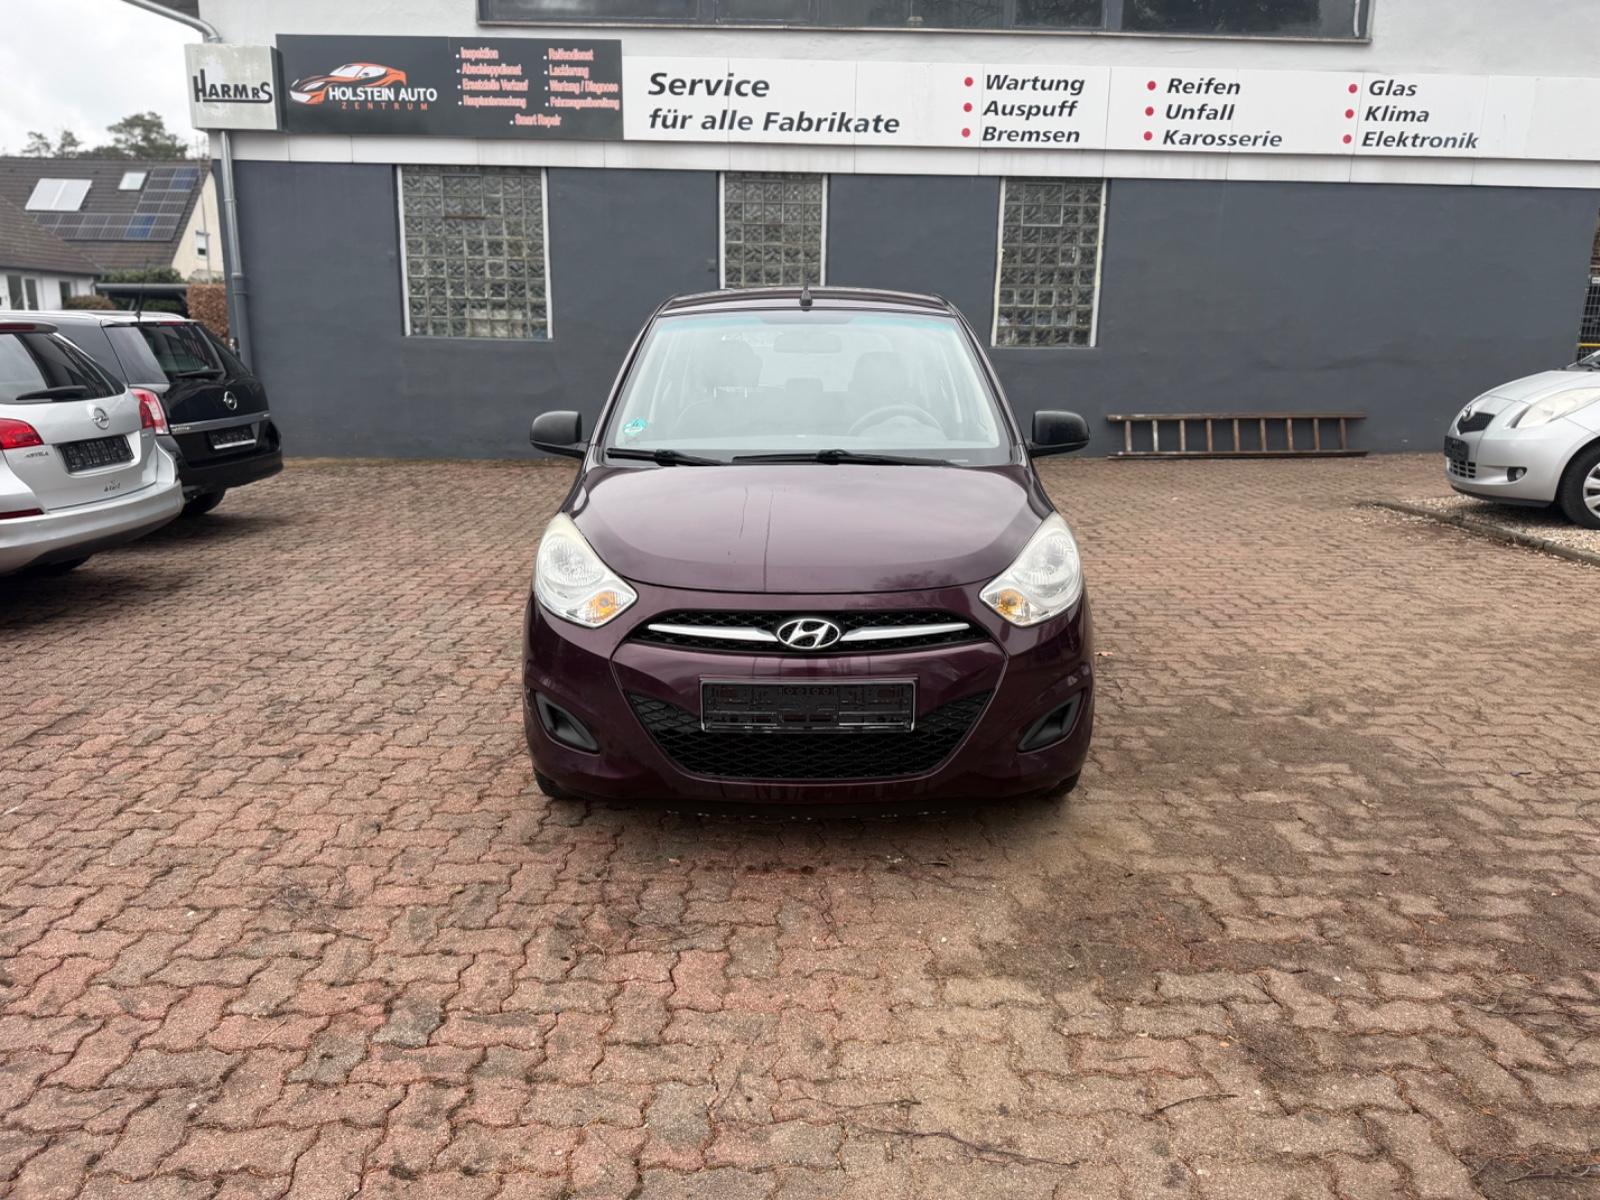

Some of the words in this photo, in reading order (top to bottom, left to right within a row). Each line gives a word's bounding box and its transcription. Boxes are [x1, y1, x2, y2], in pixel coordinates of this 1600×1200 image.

[328, 86, 395, 102] HOLSTEIN
[398, 87, 438, 102] AUTO
[648, 73, 770, 97] Service
[986, 74, 1085, 96] Wartung
[1167, 77, 1241, 95] Reifen
[1369, 79, 1417, 97] Glas
[341, 102, 429, 111] ZENTRUM
[983, 100, 1078, 120] Auspuff
[1165, 103, 1235, 121] Unfall
[1364, 105, 1430, 123] Klima
[649, 108, 693, 130] für
[701, 110, 753, 131] alle
[763, 112, 900, 134] Fabrikate
[982, 126, 1080, 145] Bremsen
[1163, 129, 1283, 147] Karosserie
[1362, 131, 1478, 148] Elektronik
